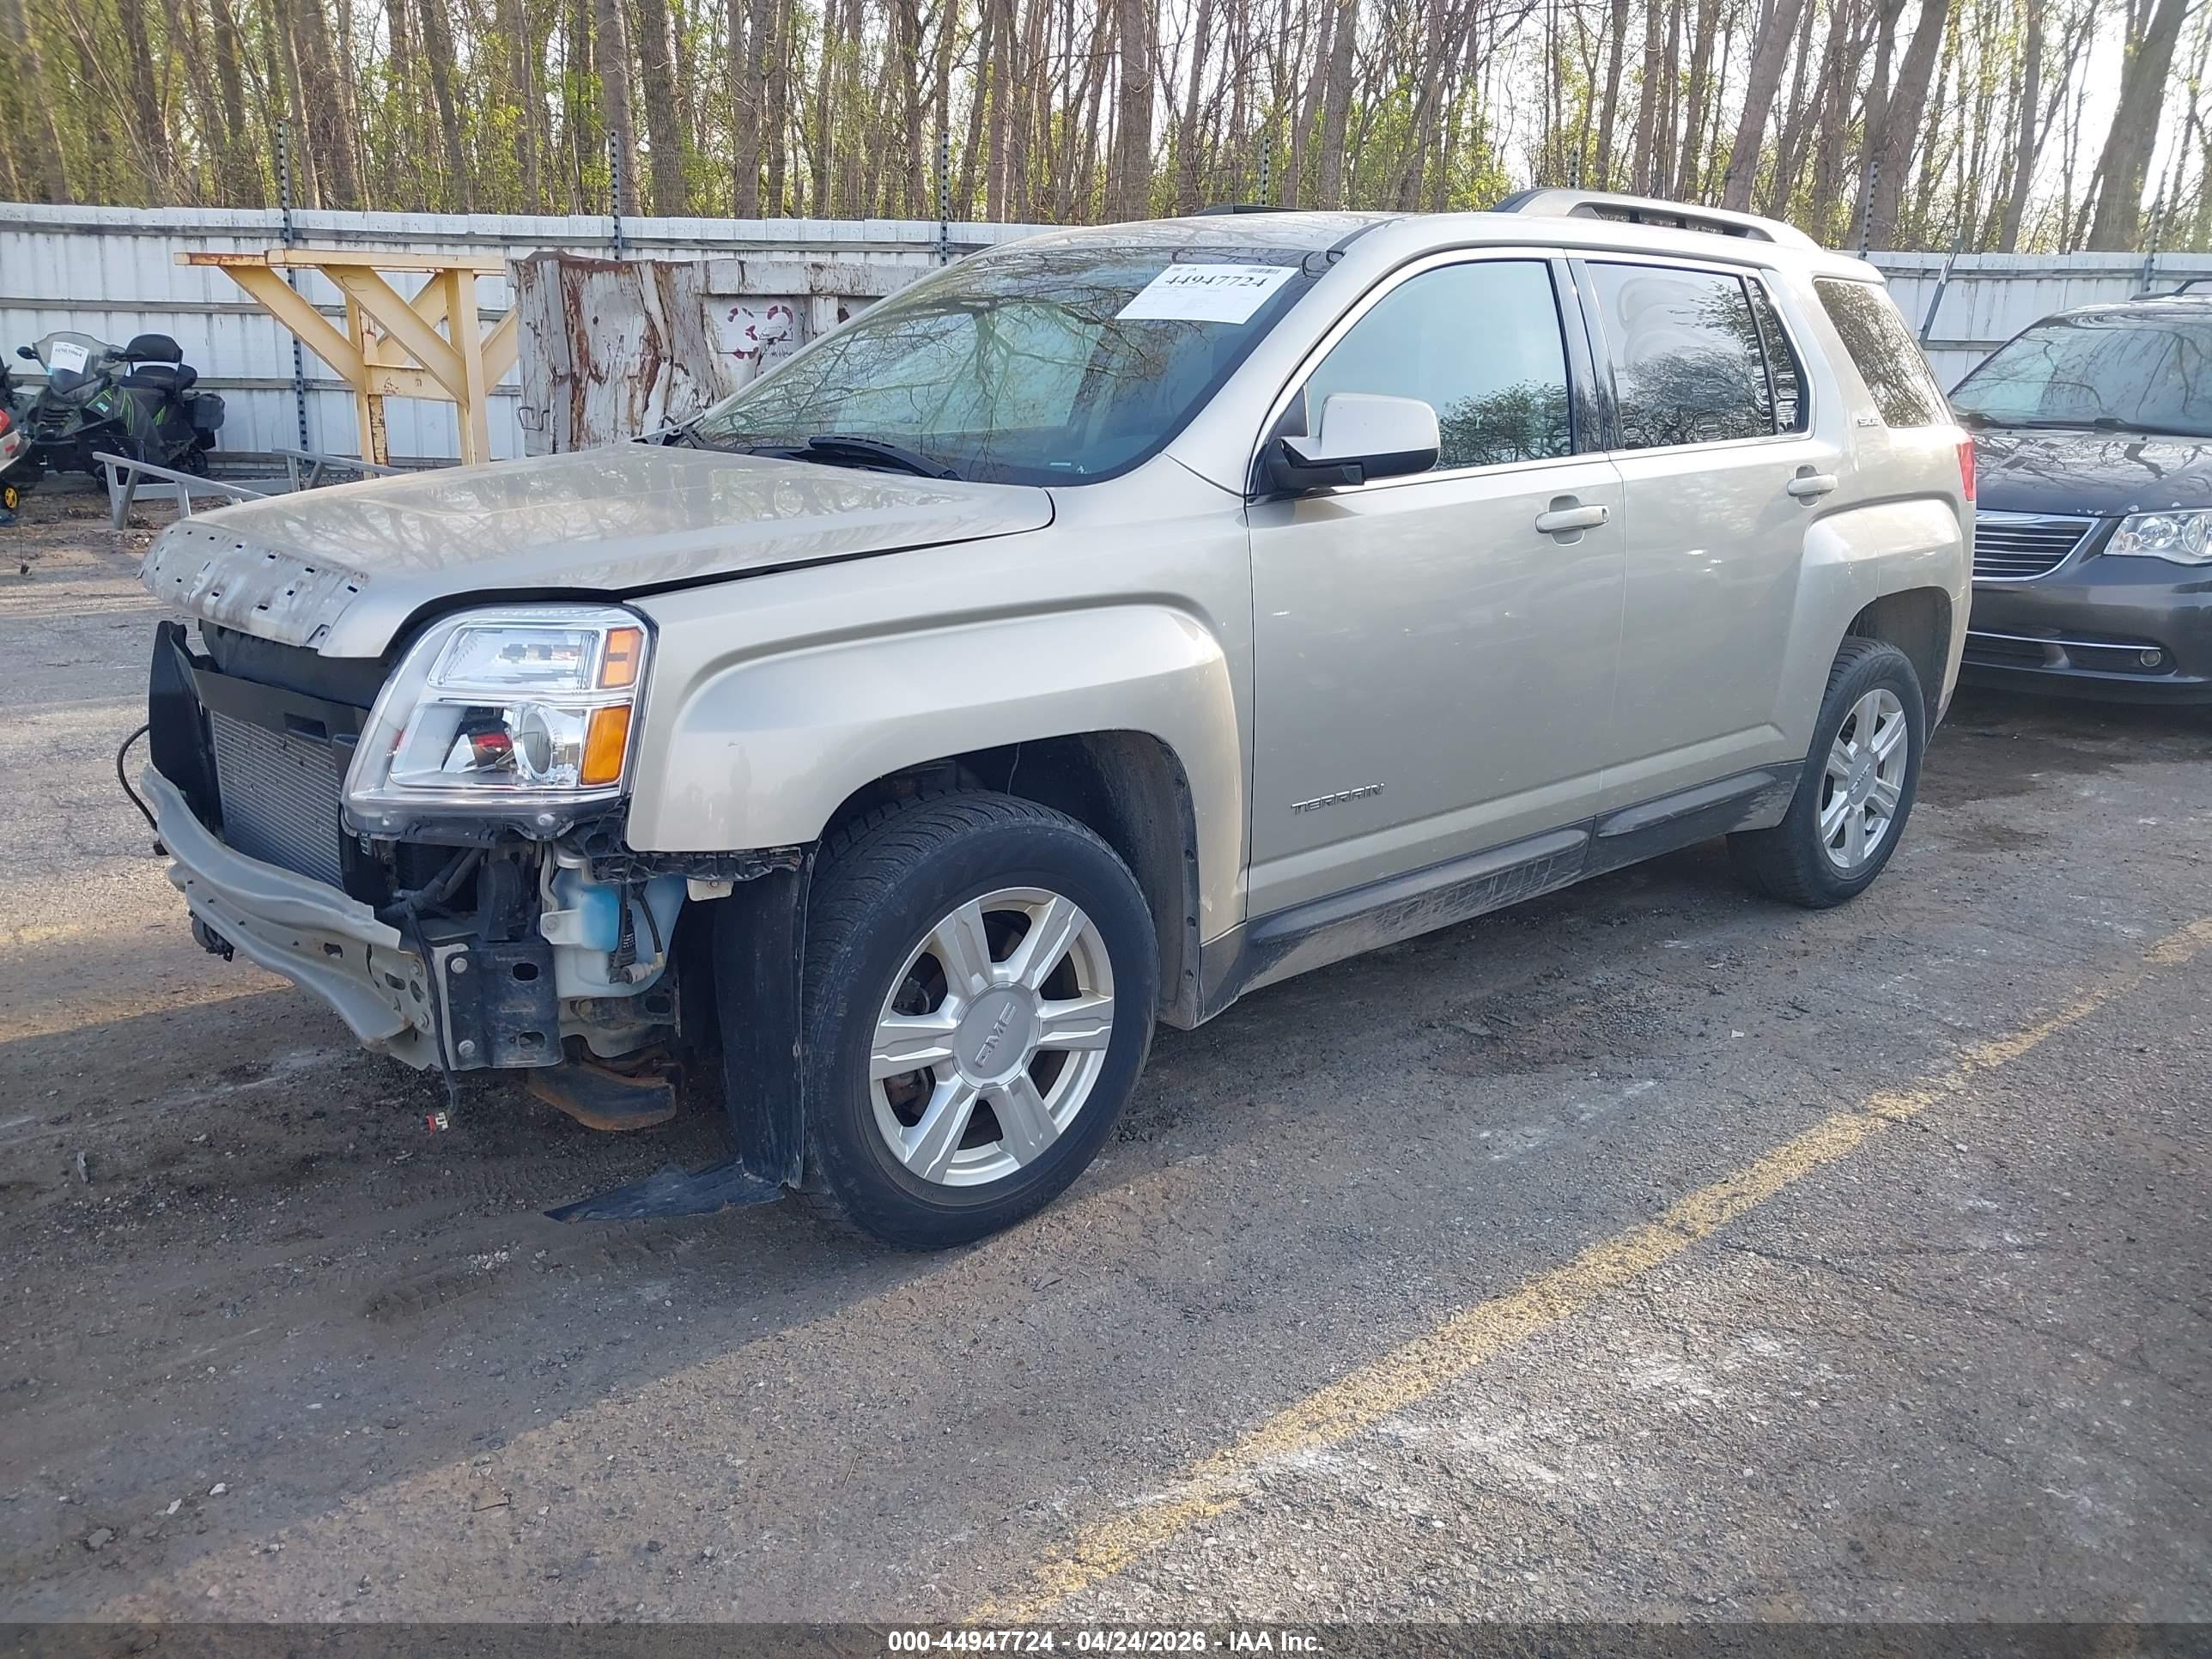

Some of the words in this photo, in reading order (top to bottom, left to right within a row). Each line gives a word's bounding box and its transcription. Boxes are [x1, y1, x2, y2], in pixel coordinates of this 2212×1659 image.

[1165, 274, 1268, 288] 44947724
[1291, 782, 1385, 815] TERRAIN
[975, 1002, 1017, 1067] GMC
